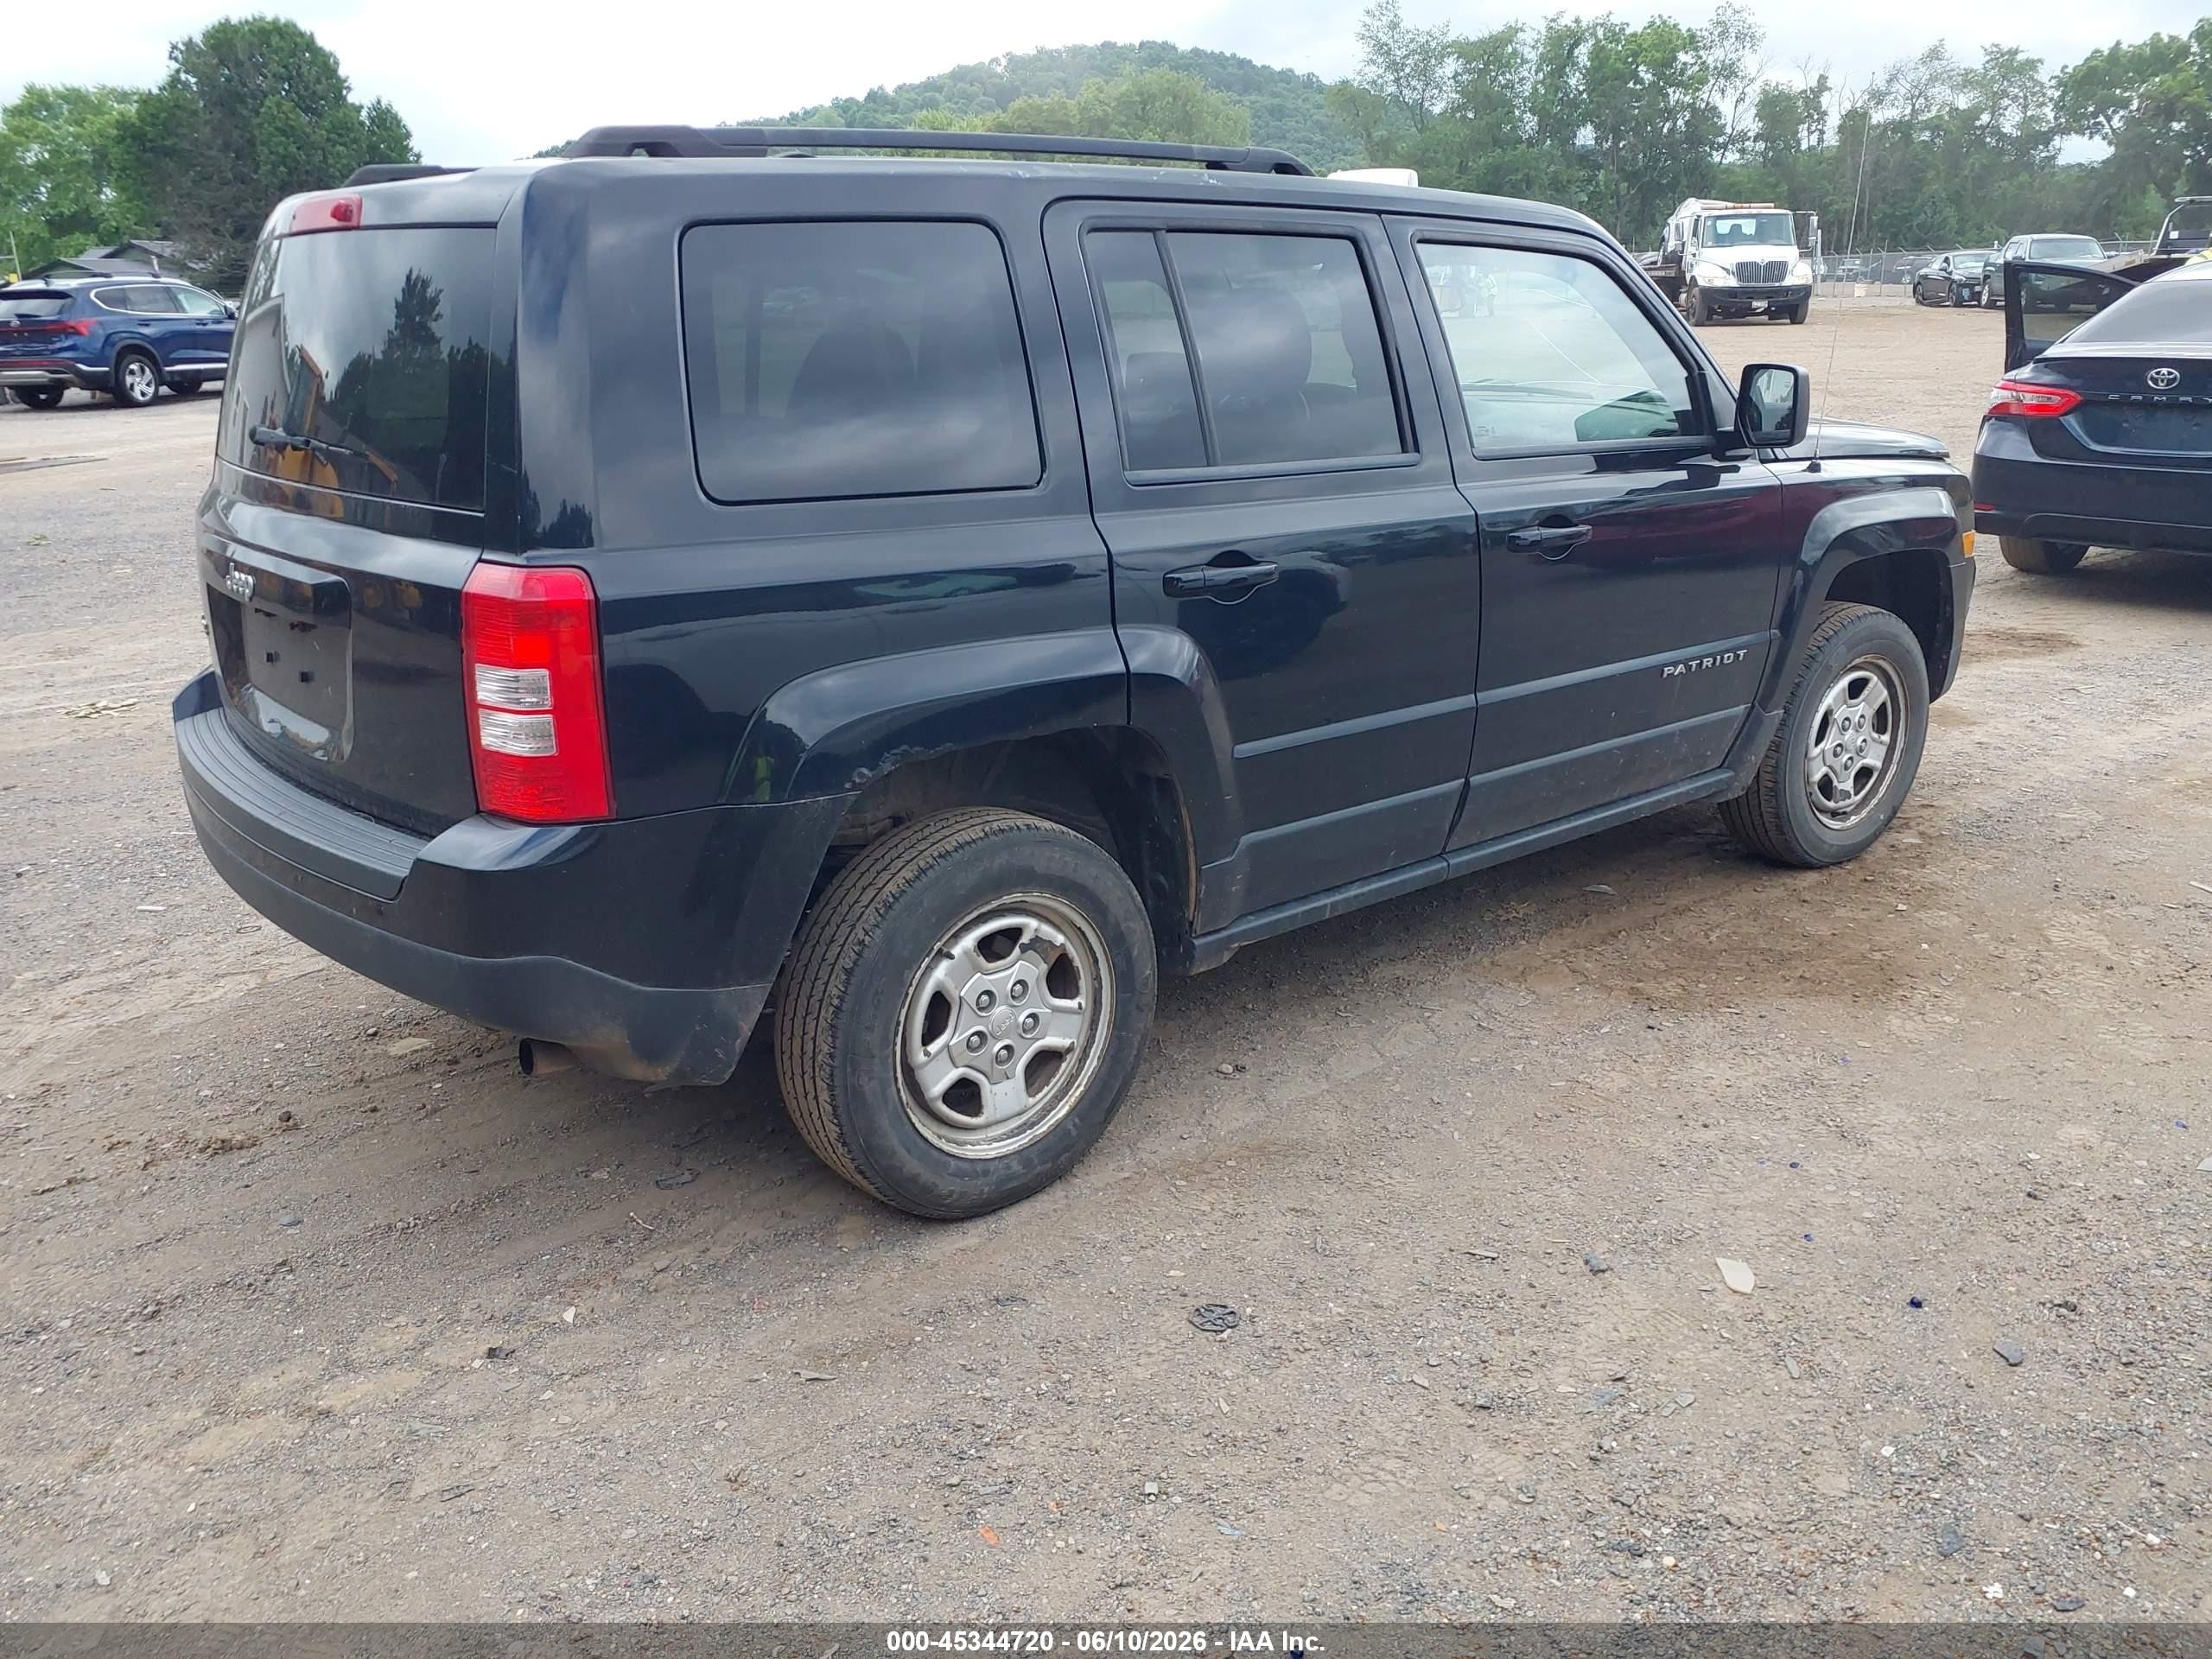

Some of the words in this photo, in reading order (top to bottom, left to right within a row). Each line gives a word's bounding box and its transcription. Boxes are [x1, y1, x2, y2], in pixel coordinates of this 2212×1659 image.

[2107, 394, 2212, 404] CAMRY
[226, 563, 254, 602] Jeep
[1662, 649, 1748, 678] PATRIOT
